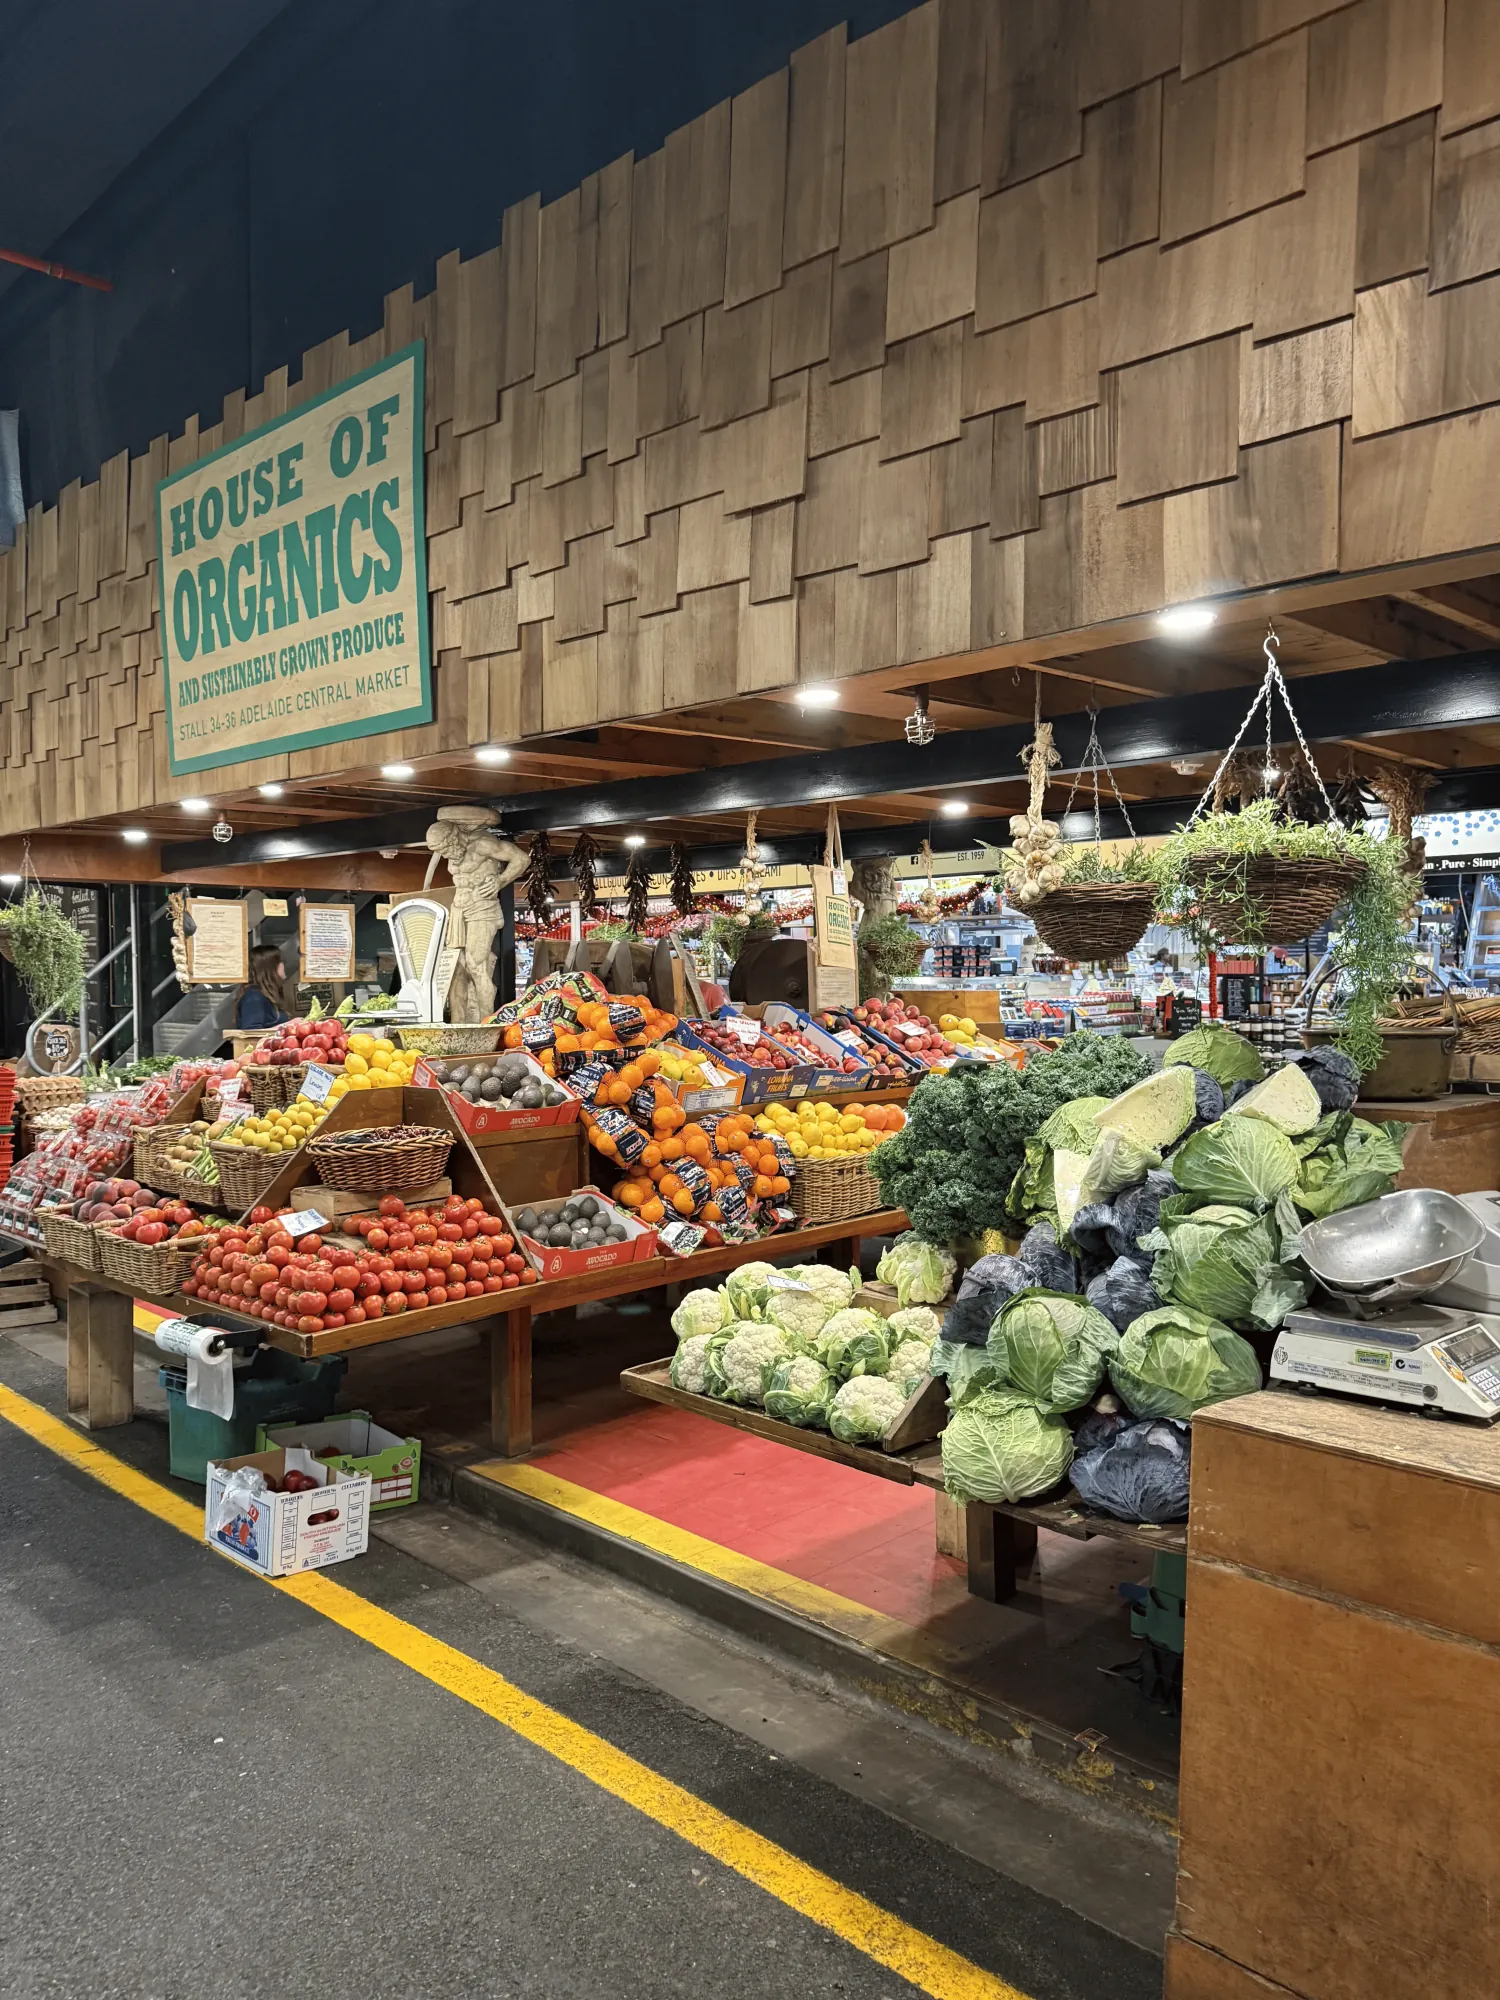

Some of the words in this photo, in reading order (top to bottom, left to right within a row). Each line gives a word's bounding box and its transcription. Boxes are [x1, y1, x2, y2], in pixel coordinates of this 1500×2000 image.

[170, 442, 303, 557] HOUSE
[329, 393, 400, 479] OF
[173, 477, 403, 662] ORGANICS
[178, 676, 200, 708] AND
[201, 652, 277, 702] SUSTAINABLY
[280, 635, 330, 677] GROWN
[333, 612, 405, 662] PRODUCE
[179, 717, 208, 741] STALL
[210, 707, 237, 734] 34-36
[239, 694, 293, 726] ADELAIDE
[296, 679, 352, 712] CENTRAL
[355, 664, 411, 697] MARKET
[957, 852, 969, 862] EST.
[971, 851, 984, 861] 1959
[1442, 859, 1465, 869] Pure
[510, 1115, 541, 1125] AVOCADO
[586, 1252, 618, 1265] AVOCADO
